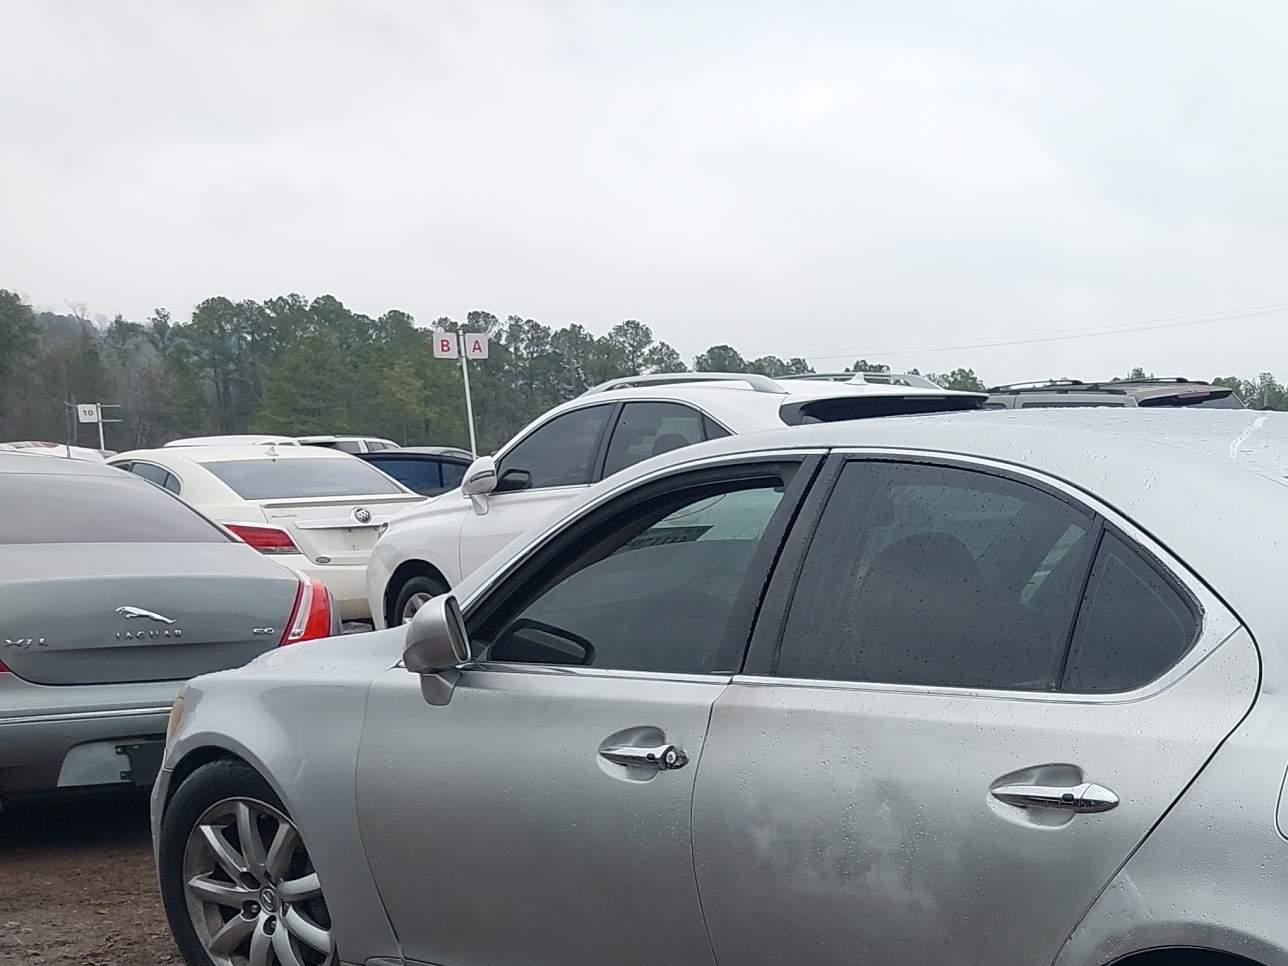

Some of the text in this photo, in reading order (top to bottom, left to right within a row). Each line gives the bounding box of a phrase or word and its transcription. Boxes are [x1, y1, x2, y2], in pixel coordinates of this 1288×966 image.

[440, 339, 451, 353] B
[472, 339, 483, 353] A
[82, 409, 94, 417] 10
[115, 628, 184, 640] JAGUAR
